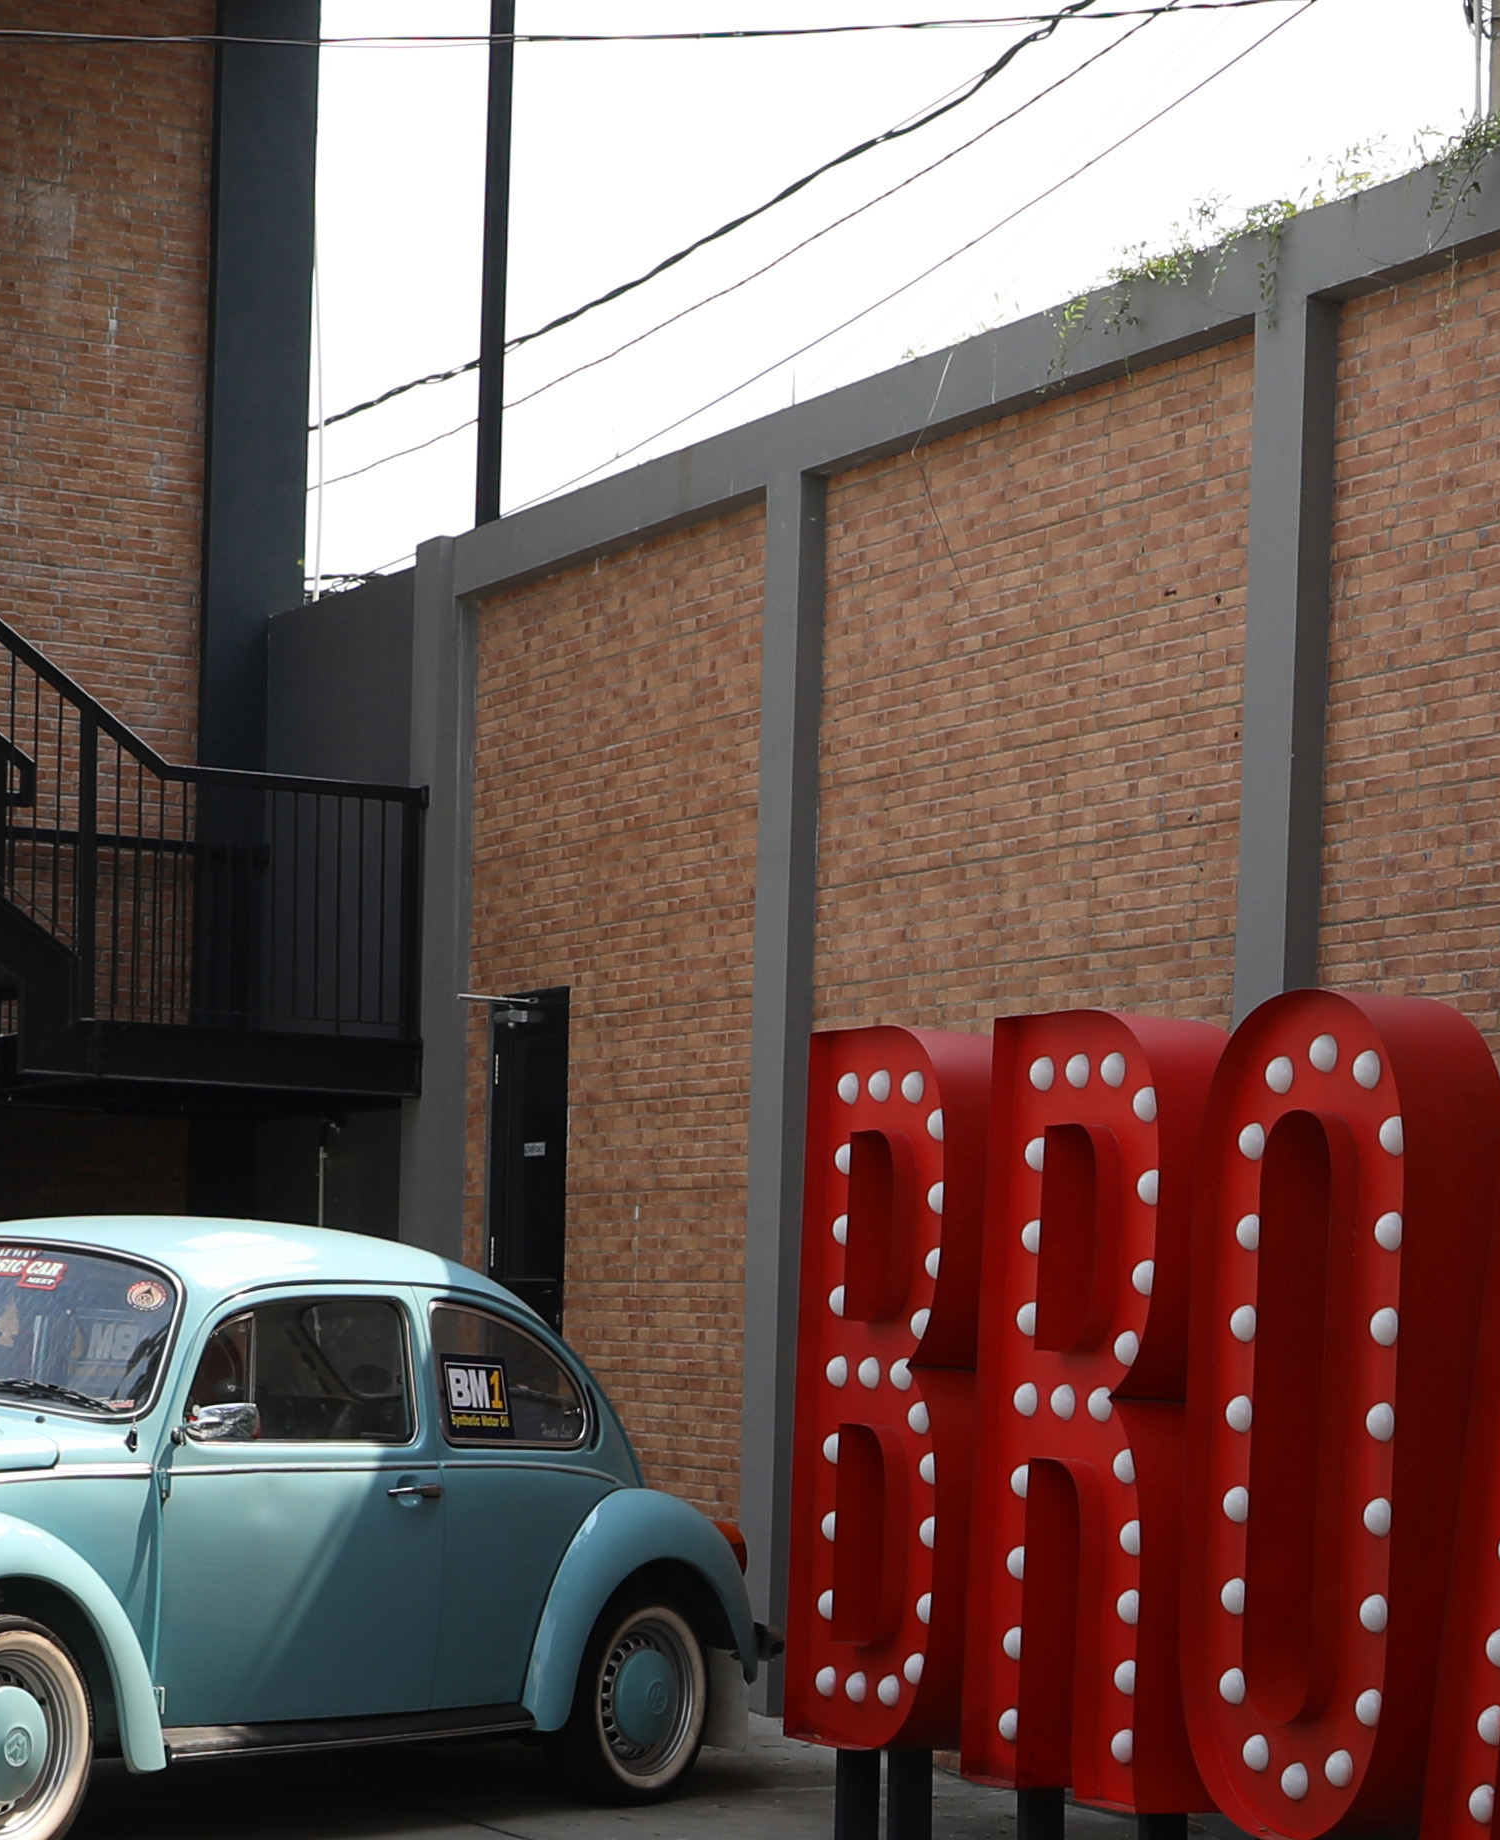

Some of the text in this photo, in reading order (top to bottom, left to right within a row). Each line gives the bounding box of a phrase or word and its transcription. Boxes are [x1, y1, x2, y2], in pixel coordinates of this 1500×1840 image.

[26, 1261, 63, 1276] CAR
[448, 1367, 503, 1409] BM1
[451, 1413, 480, 1428] Synthetic
